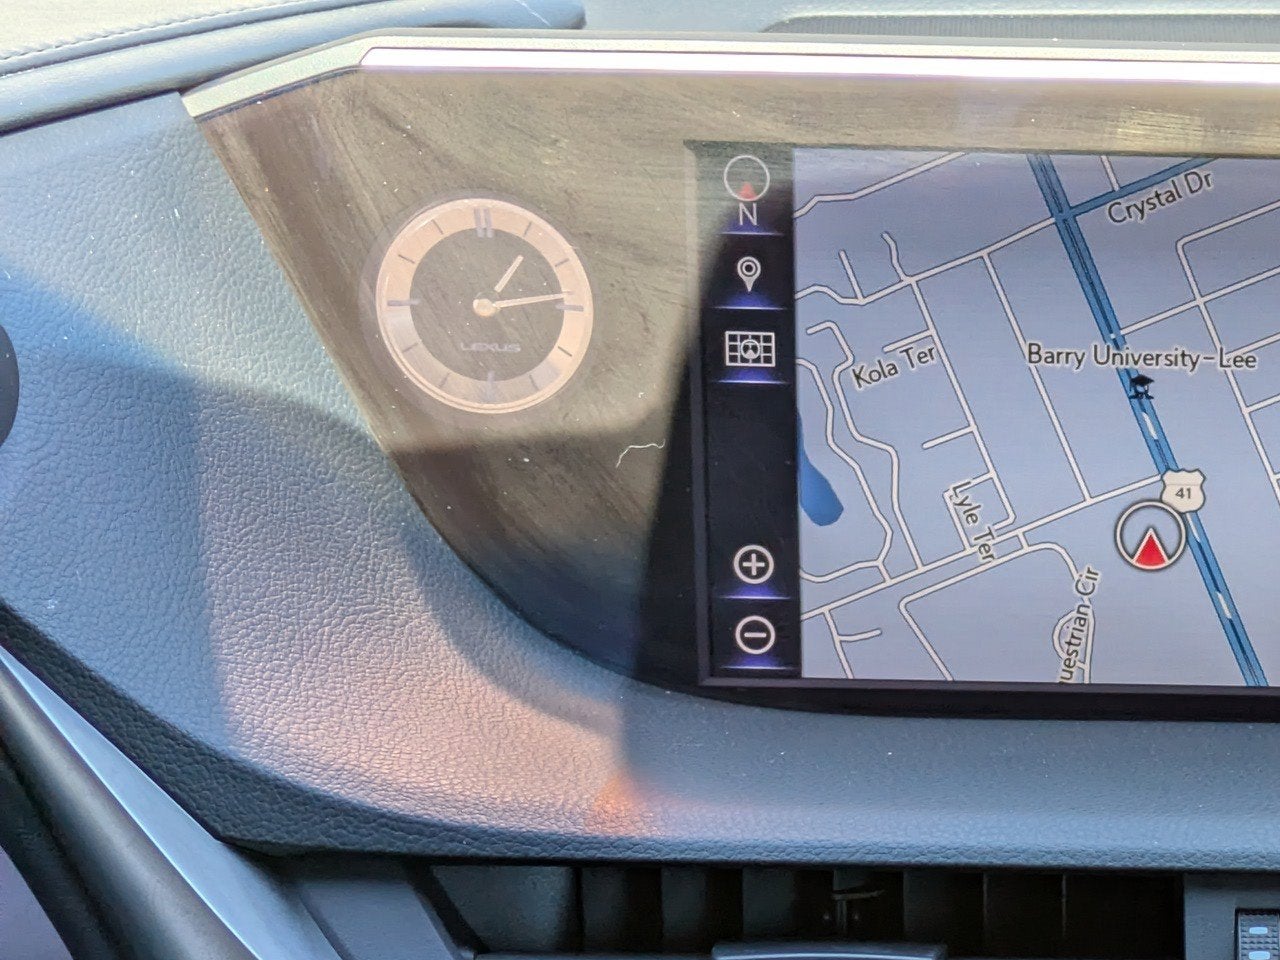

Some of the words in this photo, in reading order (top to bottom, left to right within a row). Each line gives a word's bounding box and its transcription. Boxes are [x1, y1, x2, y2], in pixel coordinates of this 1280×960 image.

[739, 202, 757, 226] N
[1108, 180, 1183, 224] Crystal
[1185, 170, 1214, 194] Dr
[852, 360, 899, 389] Kola
[902, 344, 936, 370] Ter
[1027, 342, 1086, 371] Barry
[1175, 487, 1192, 500] 41
[952, 480, 979, 526] Lyle
[972, 527, 996, 563] Ter
[1059, 603, 1091, 685] uestrian
[1075, 566, 1100, 597] Cir
